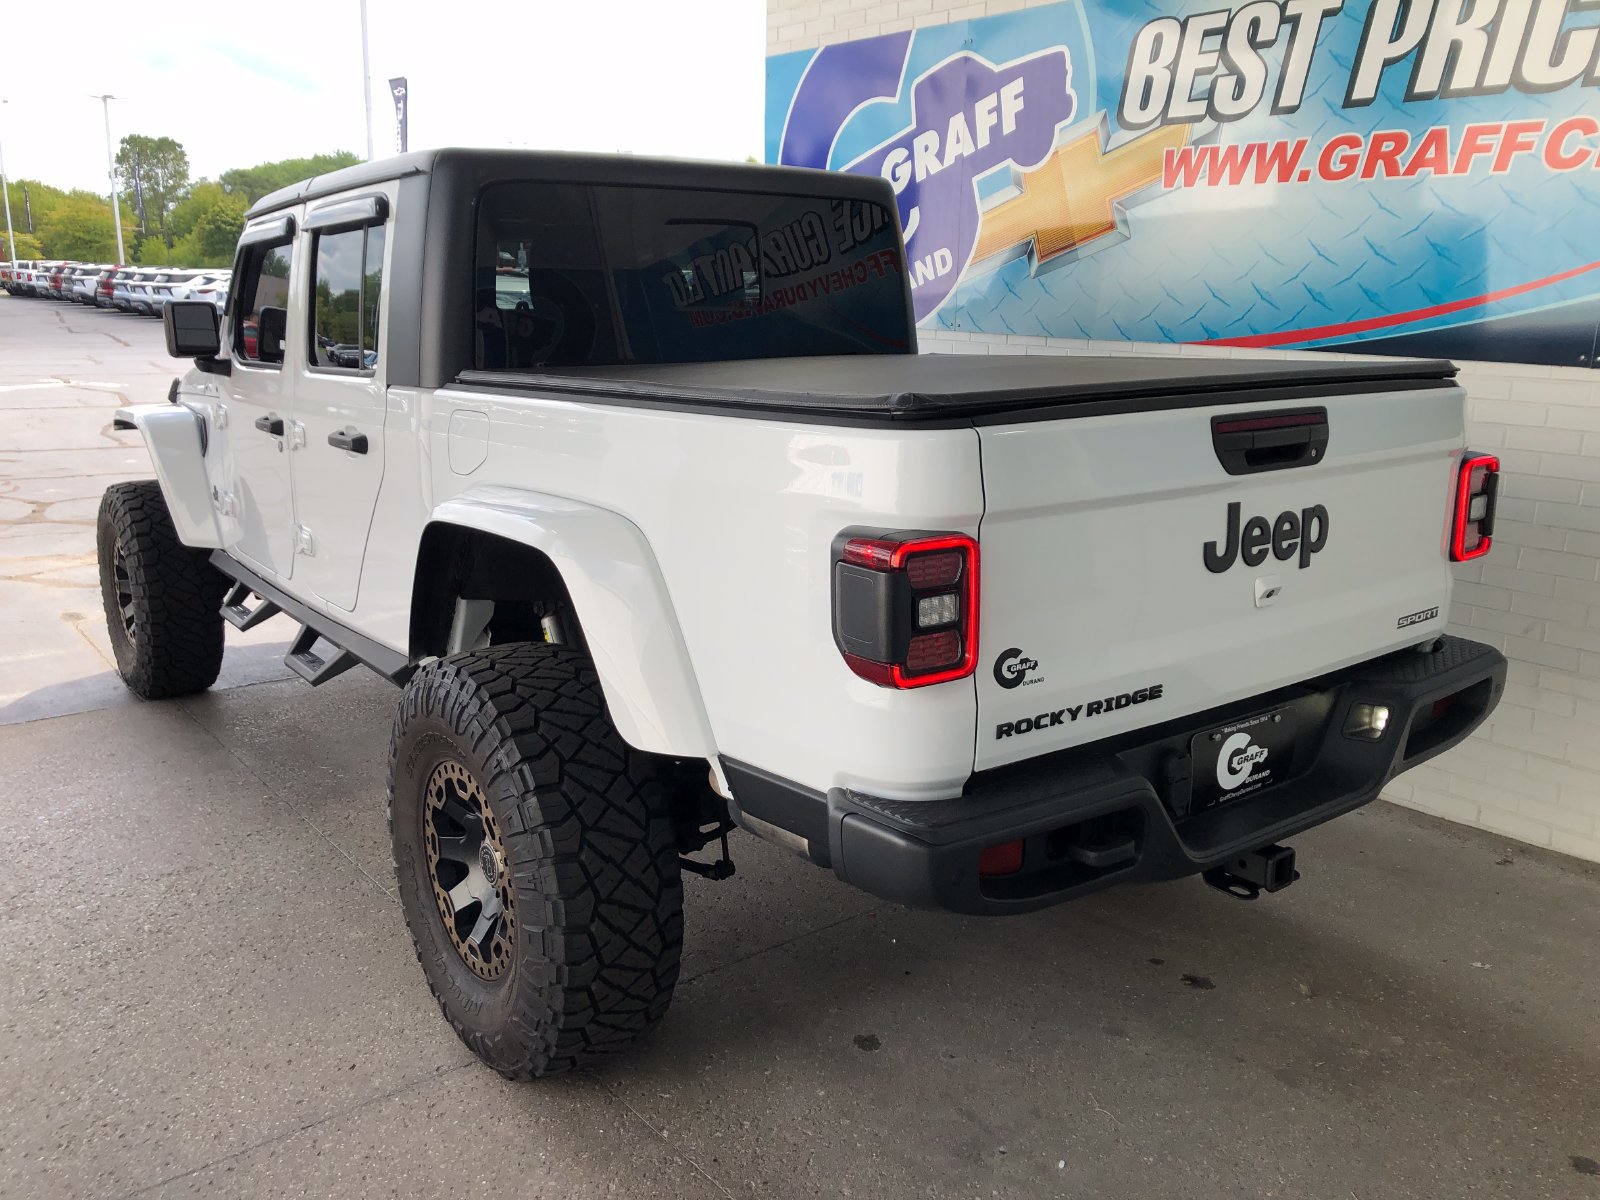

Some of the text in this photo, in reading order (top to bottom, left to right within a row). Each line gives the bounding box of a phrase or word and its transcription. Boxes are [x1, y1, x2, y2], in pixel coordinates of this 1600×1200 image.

[1118, 0, 1600, 130] BEST PRIC
[881, 77, 1024, 194] GRAFF
[1162, 118, 1600, 190] WWW.GRAFFC
[1203, 502, 1330, 573] Jeep
[1397, 607, 1439, 628] SPORT
[1010, 660, 1036, 672] GRAFF
[995, 683, 1164, 740] ROCKY RIDGE
[1237, 749, 1265, 765] GRAFF
[1245, 769, 1271, 783] DURAND
